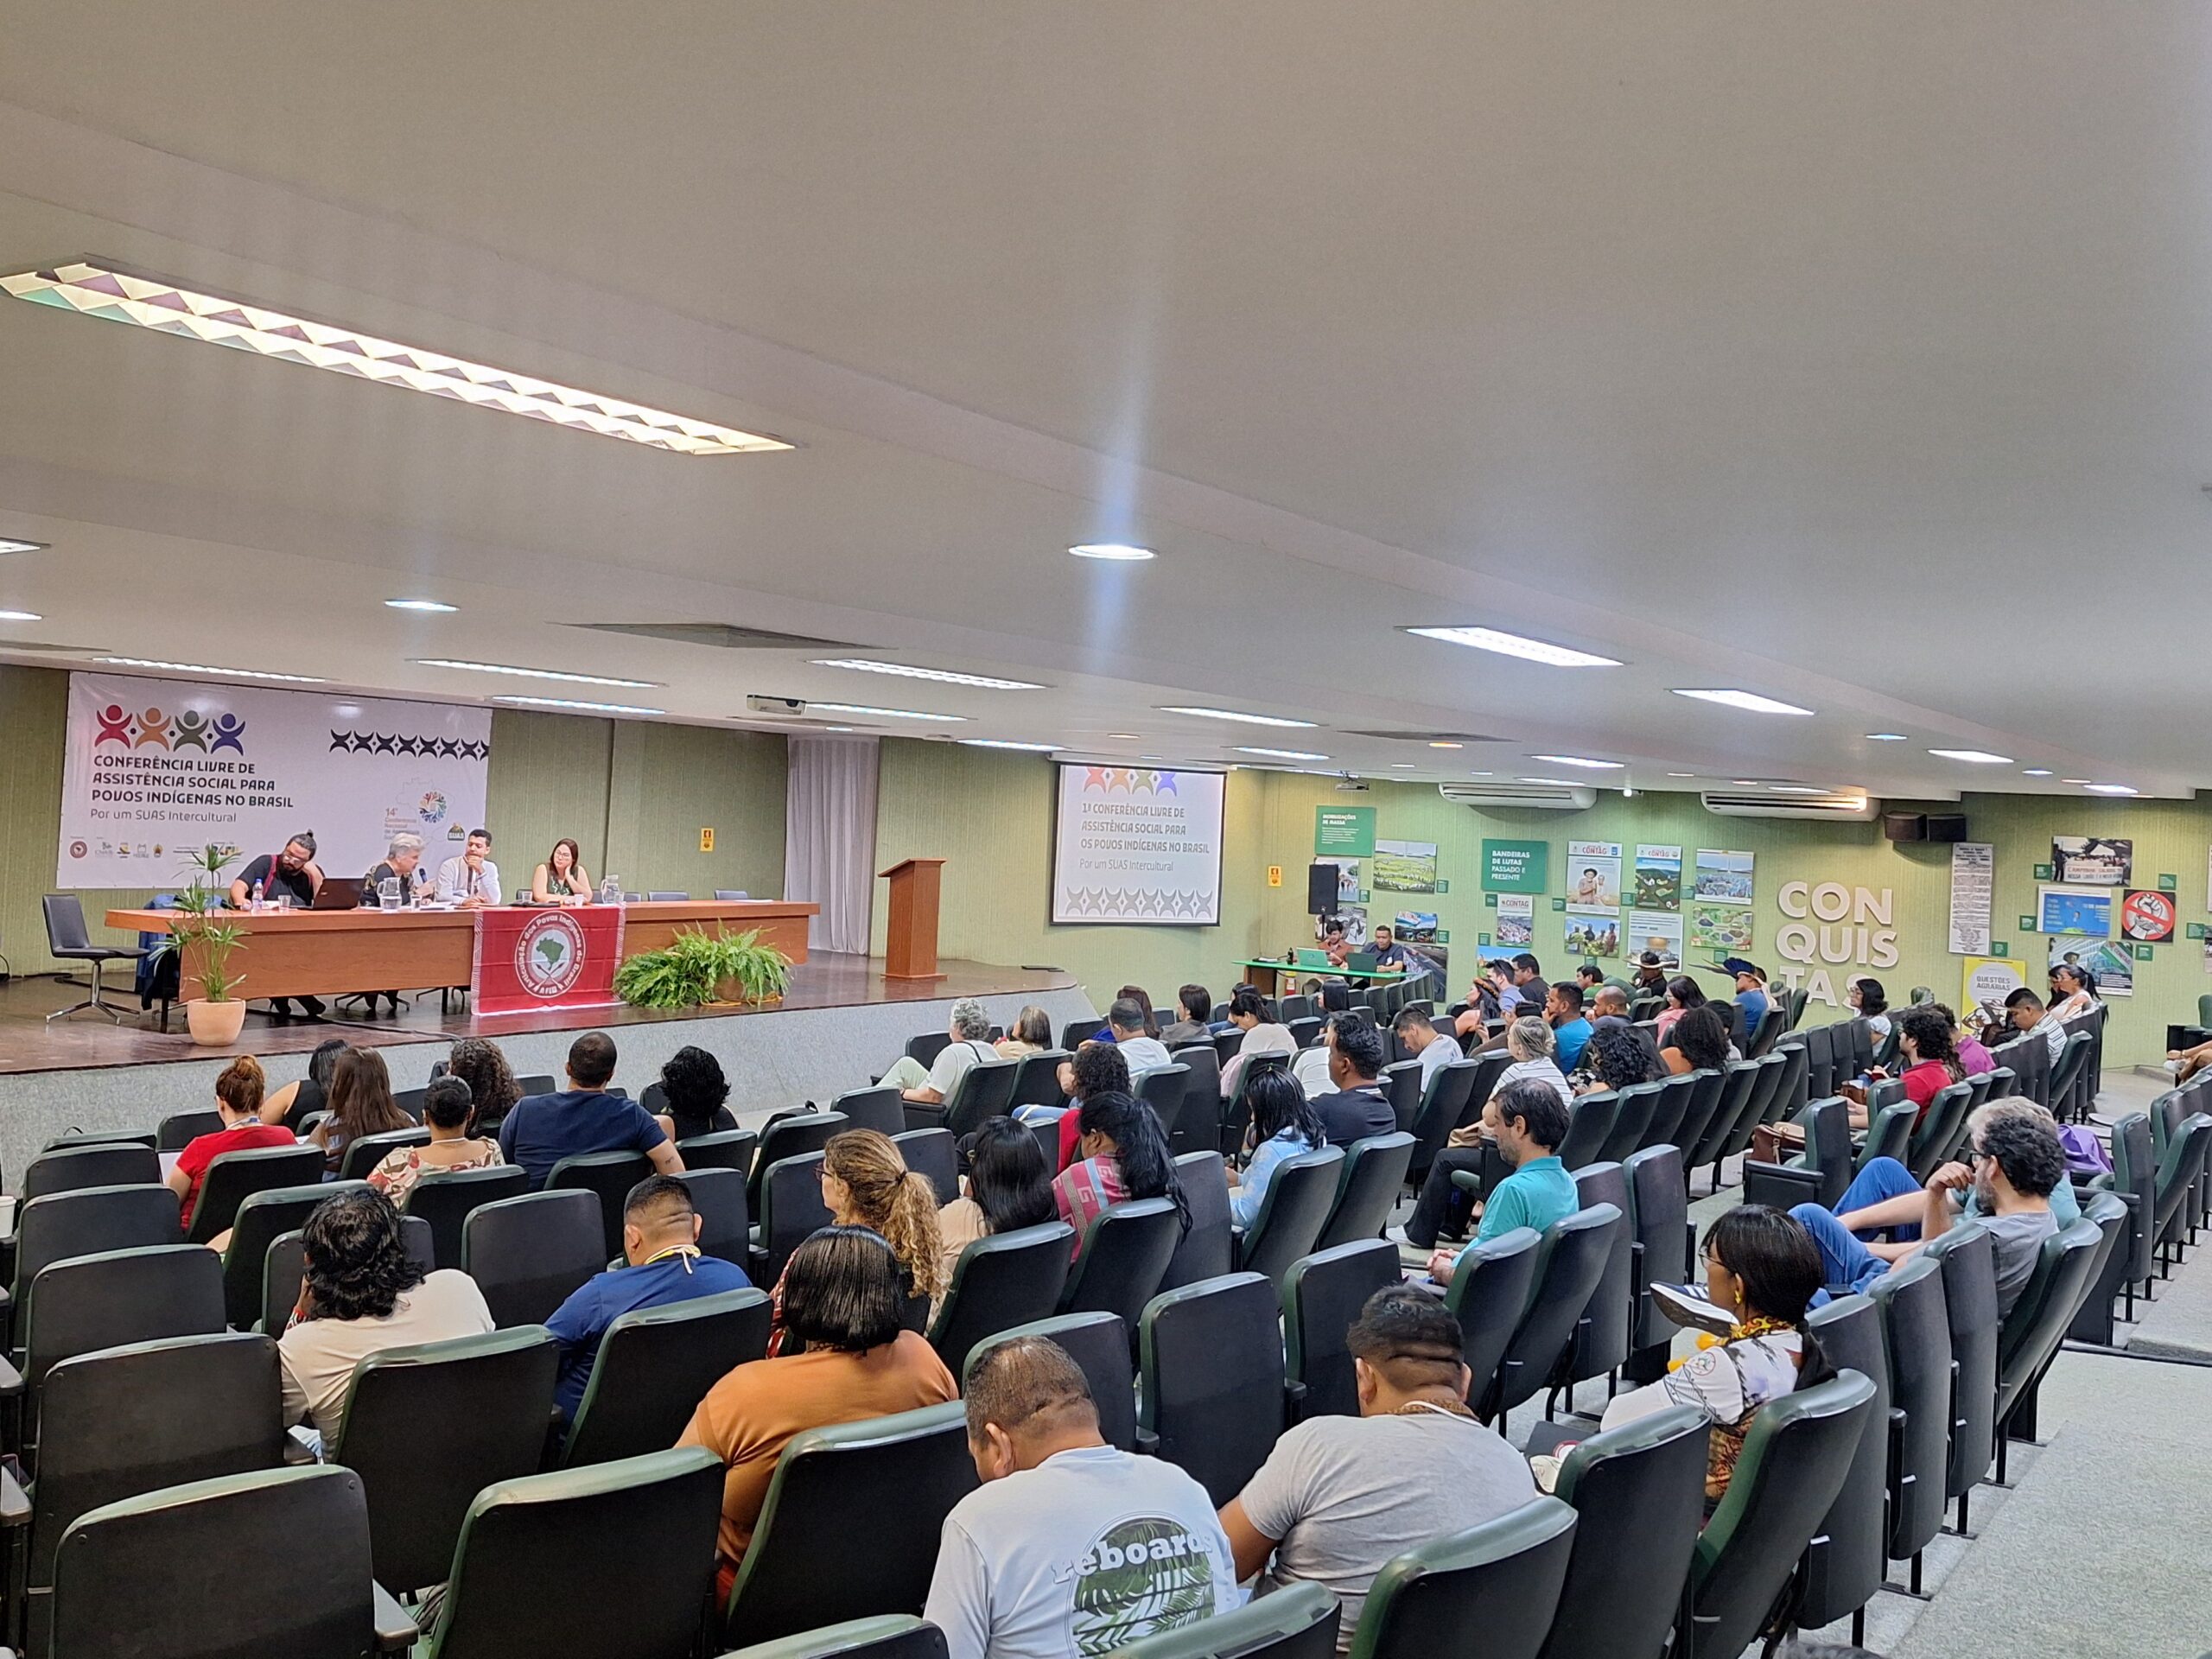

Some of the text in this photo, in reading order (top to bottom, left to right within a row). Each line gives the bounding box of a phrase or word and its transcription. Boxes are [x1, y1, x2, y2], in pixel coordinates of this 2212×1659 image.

[94, 755, 256, 774] CONFERÊNCIA LIVRE DE
[92, 772, 275, 791] ASSISTÊNCIA SOCIAL PARA
[92, 790, 294, 808] POVOS INDÍGENAS NO BRASIL
[90, 808, 237, 822] Por um SUAS Intercultural
[1093, 803, 1148, 816] CONFERÊNCIA
[1150, 807, 1172, 817] LIVRE
[1174, 808, 1185, 817] DE
[1082, 819, 1186, 836] ASSISTÊNCIA SOCIAL PARA
[1081, 838, 1210, 854] OS POVOS INDÍGENAS NO BRASIL
[1582, 846, 1607, 855] CONTAG
[1080, 858, 1173, 872] Por um SUAS Intercultural
[1778, 880, 1892, 925] CON
[1776, 924, 1898, 968] QUIS
